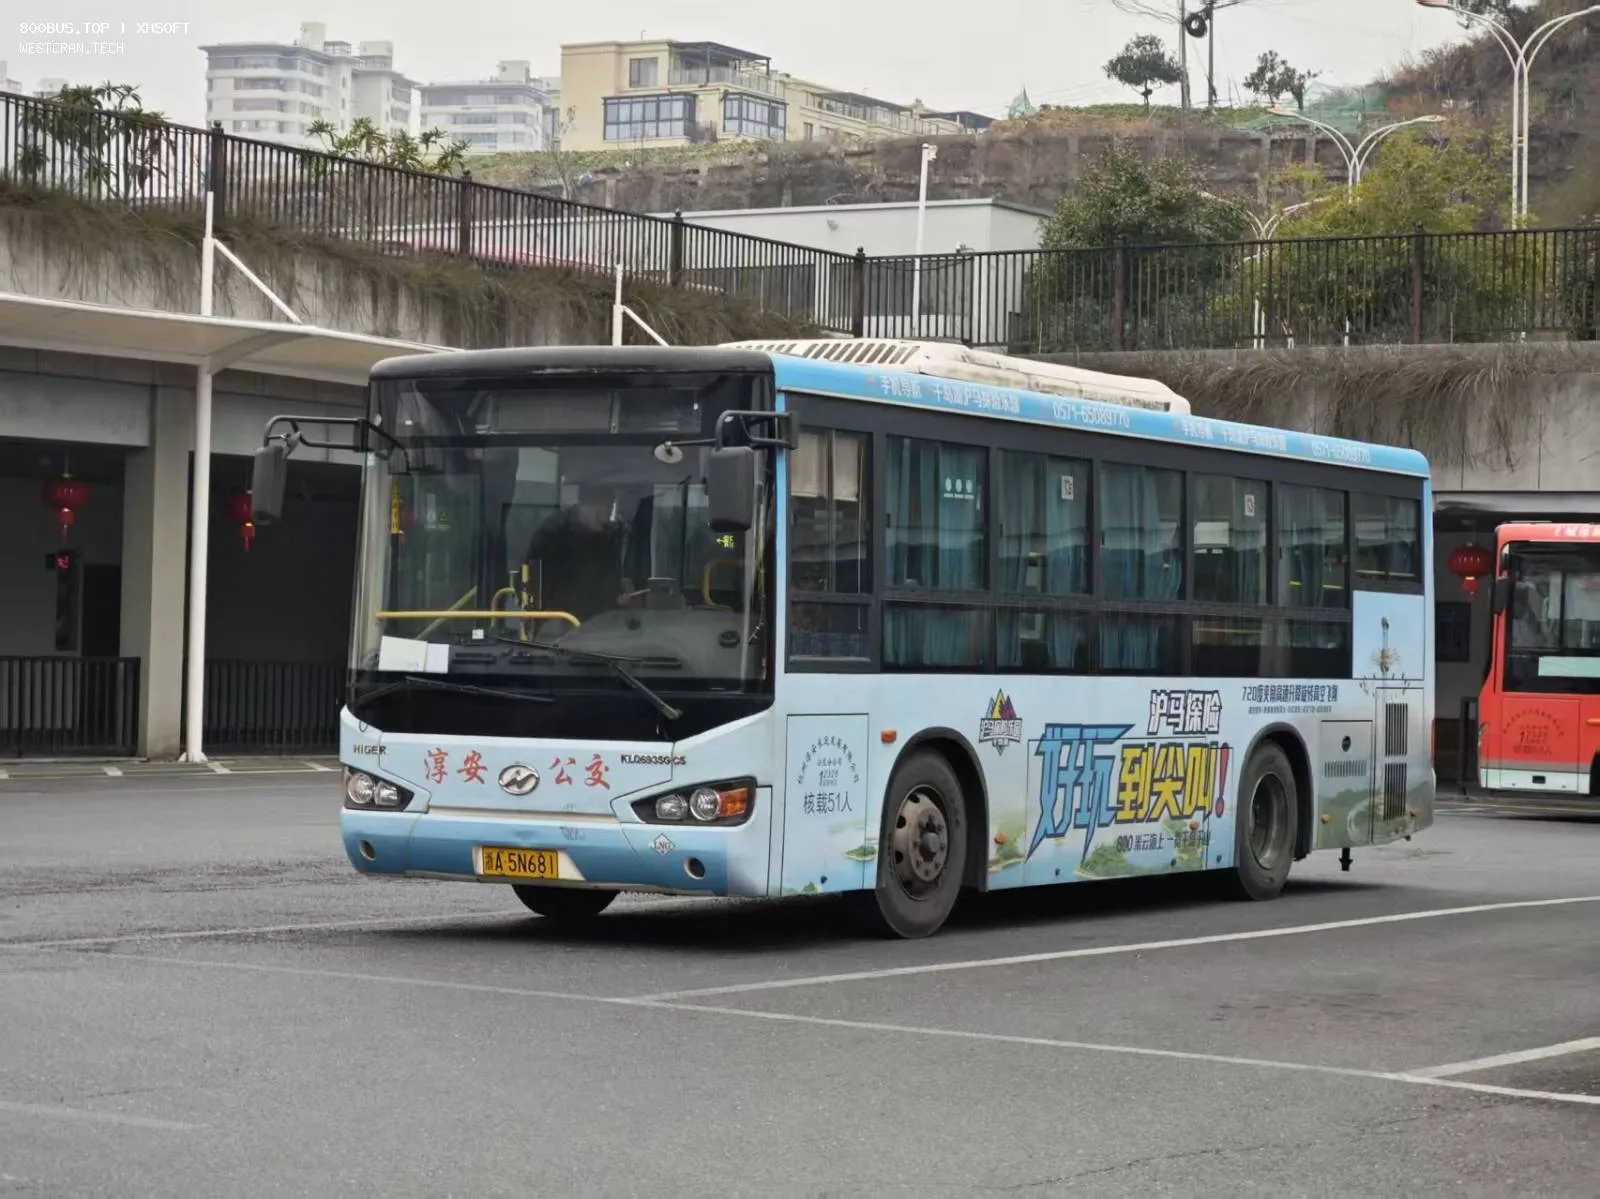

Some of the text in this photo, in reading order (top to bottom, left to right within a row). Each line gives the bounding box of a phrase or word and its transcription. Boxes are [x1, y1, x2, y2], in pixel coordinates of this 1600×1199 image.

[1147, 689, 1222, 735] 沪马探险
[352, 744, 387, 756] HIGER
[424, 747, 611, 790] 淳安 公交
[803, 791, 852, 814] 核载51人
